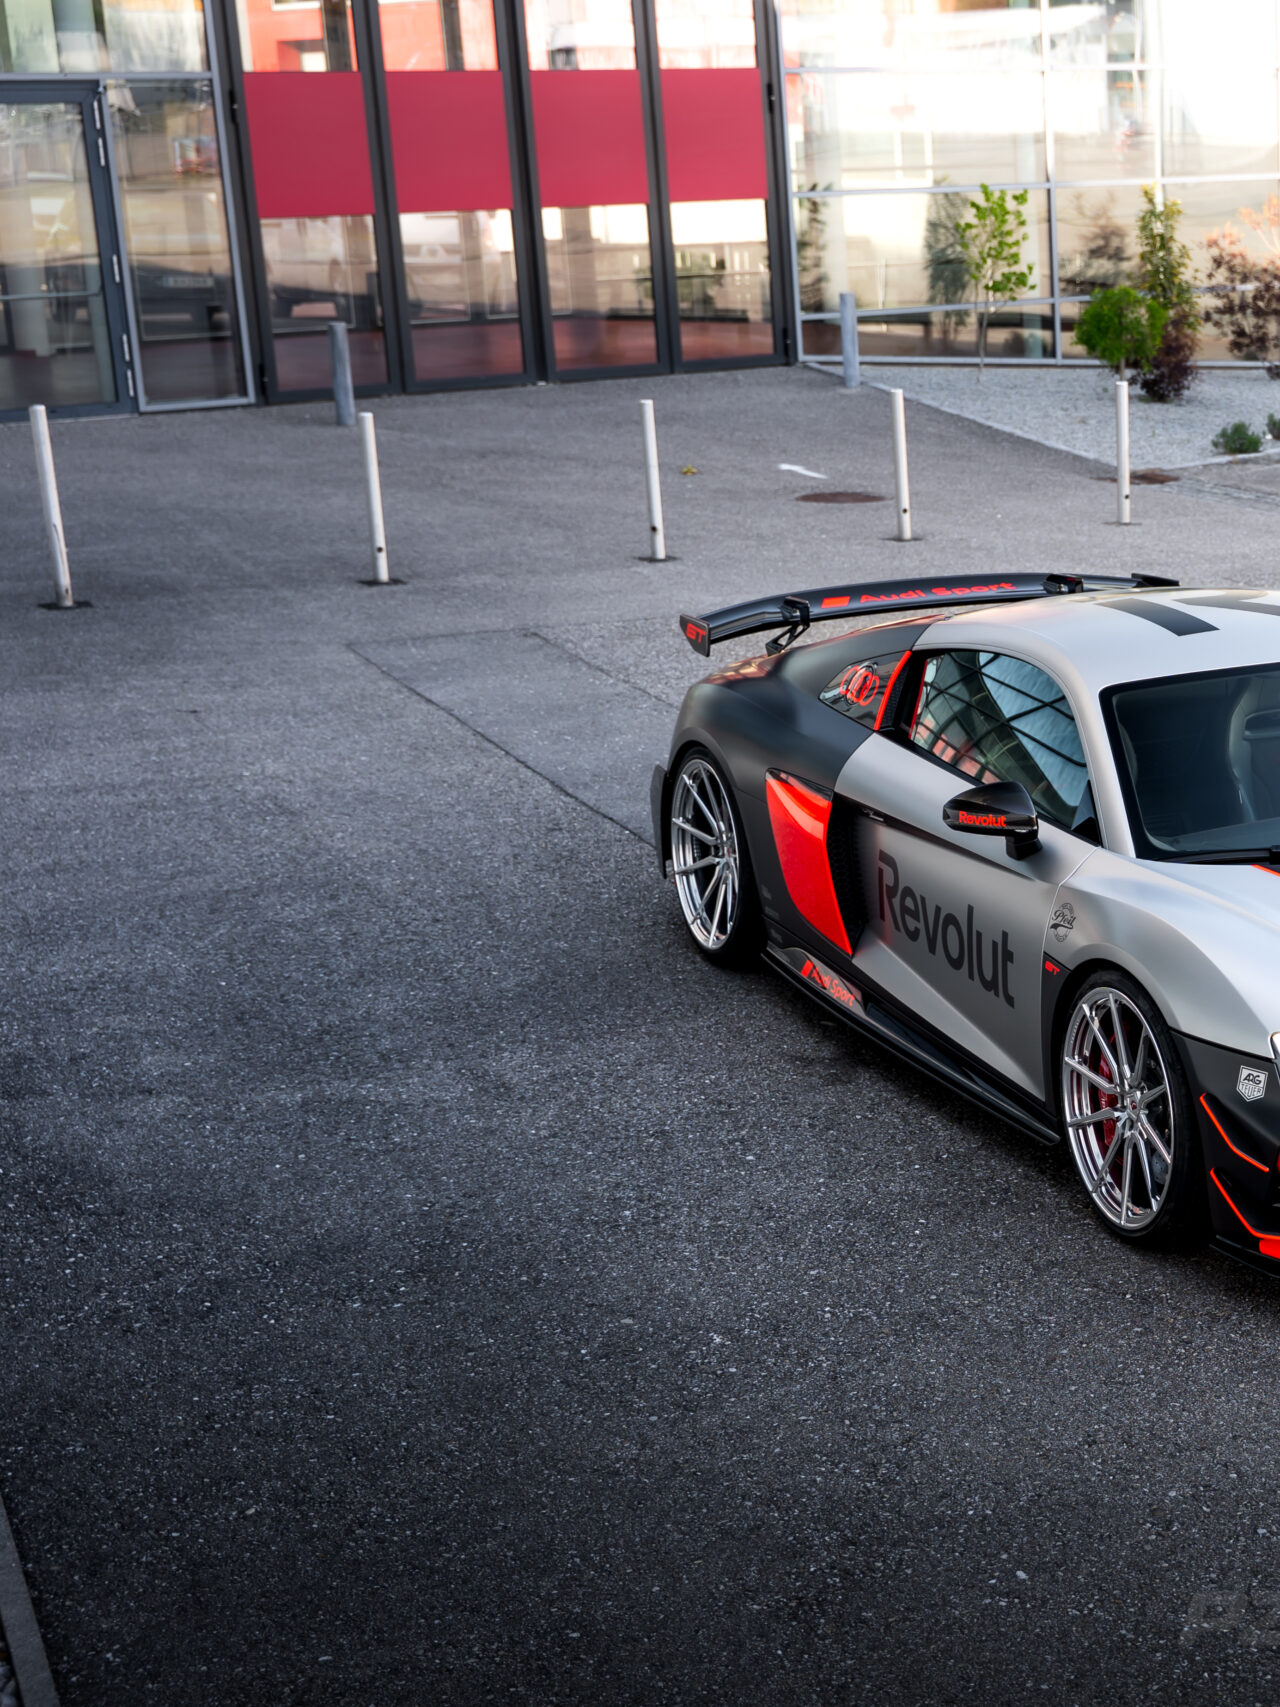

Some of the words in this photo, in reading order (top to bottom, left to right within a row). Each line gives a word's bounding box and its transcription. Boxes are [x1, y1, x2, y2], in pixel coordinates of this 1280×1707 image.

[860, 589, 927, 603] Audi
[931, 582, 1017, 597] Sport
[686, 622, 707, 643] GT
[958, 810, 1007, 828] Revolut
[877, 848, 1016, 1009] Revolut
[1052, 909, 1077, 929] Pfeil
[1045, 960, 1060, 975] GT
[831, 979, 856, 1007] Sport
